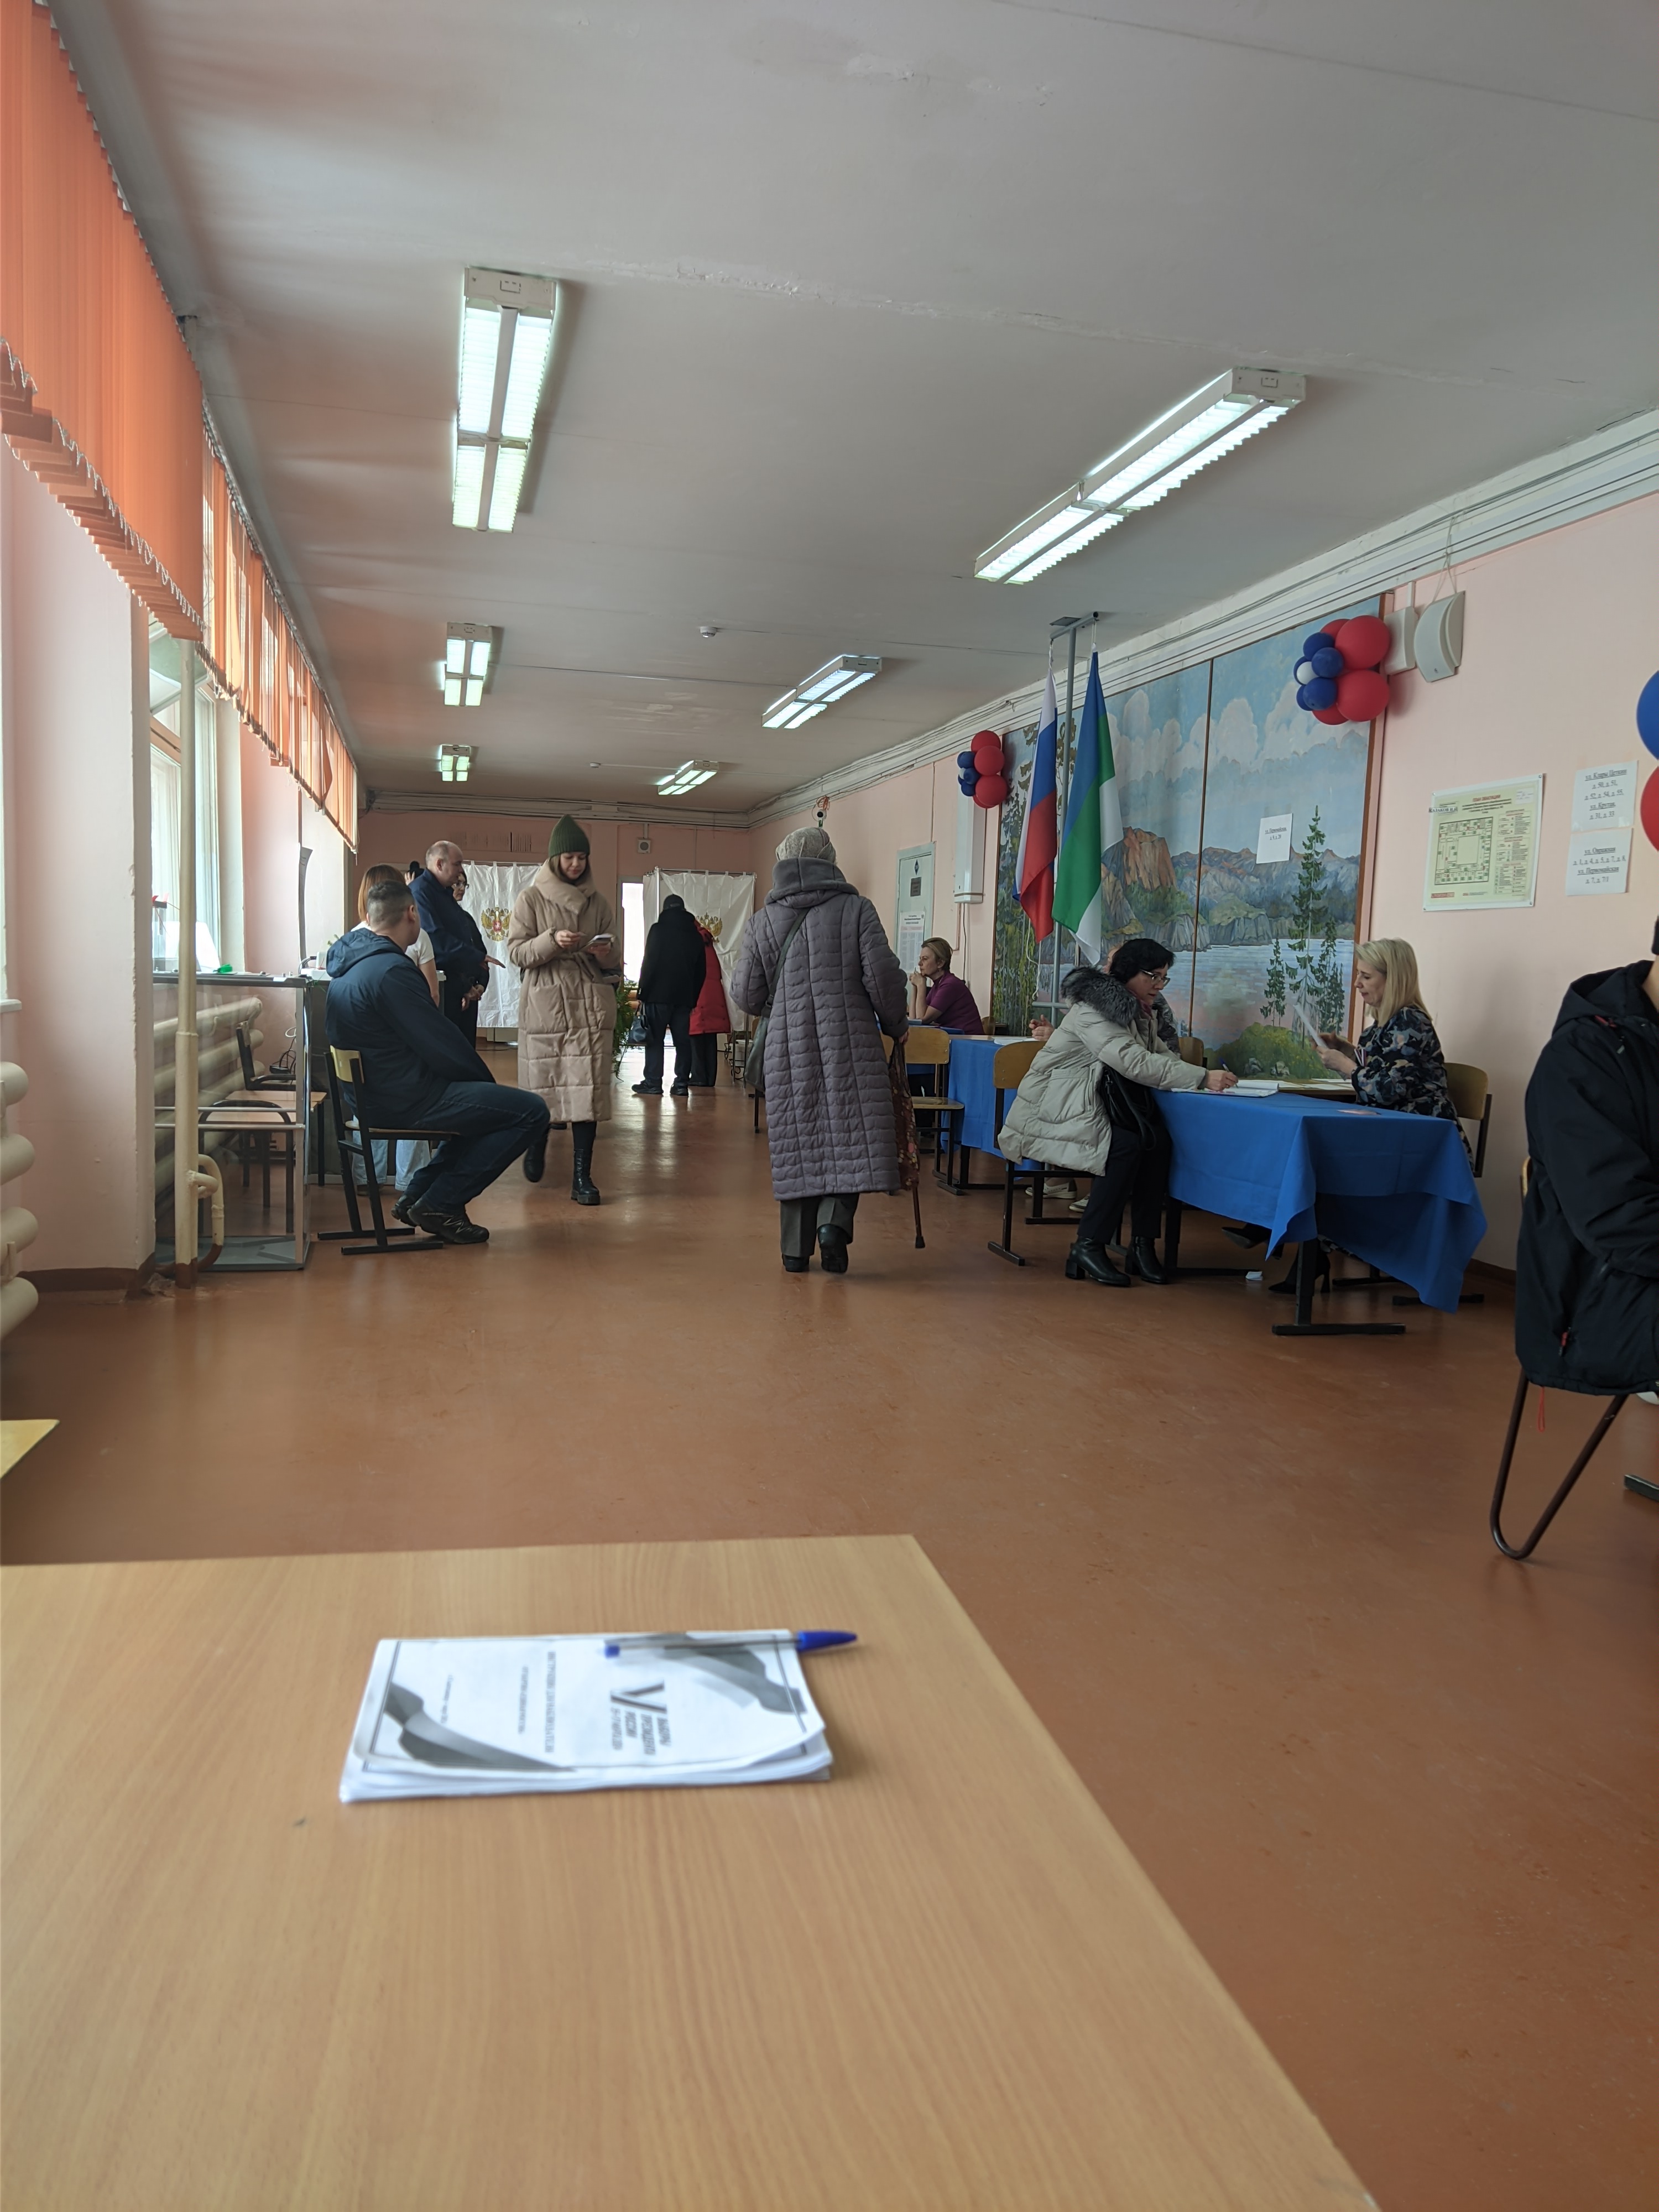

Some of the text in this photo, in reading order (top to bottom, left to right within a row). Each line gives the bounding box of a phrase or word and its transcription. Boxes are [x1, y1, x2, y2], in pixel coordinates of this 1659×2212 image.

[624, 1710, 638, 1738] РОССИИ
[641, 1714, 656, 1755] ПРЕЗИДЕНТА
[656, 1717, 672, 1746] ВЫБОРЫ
